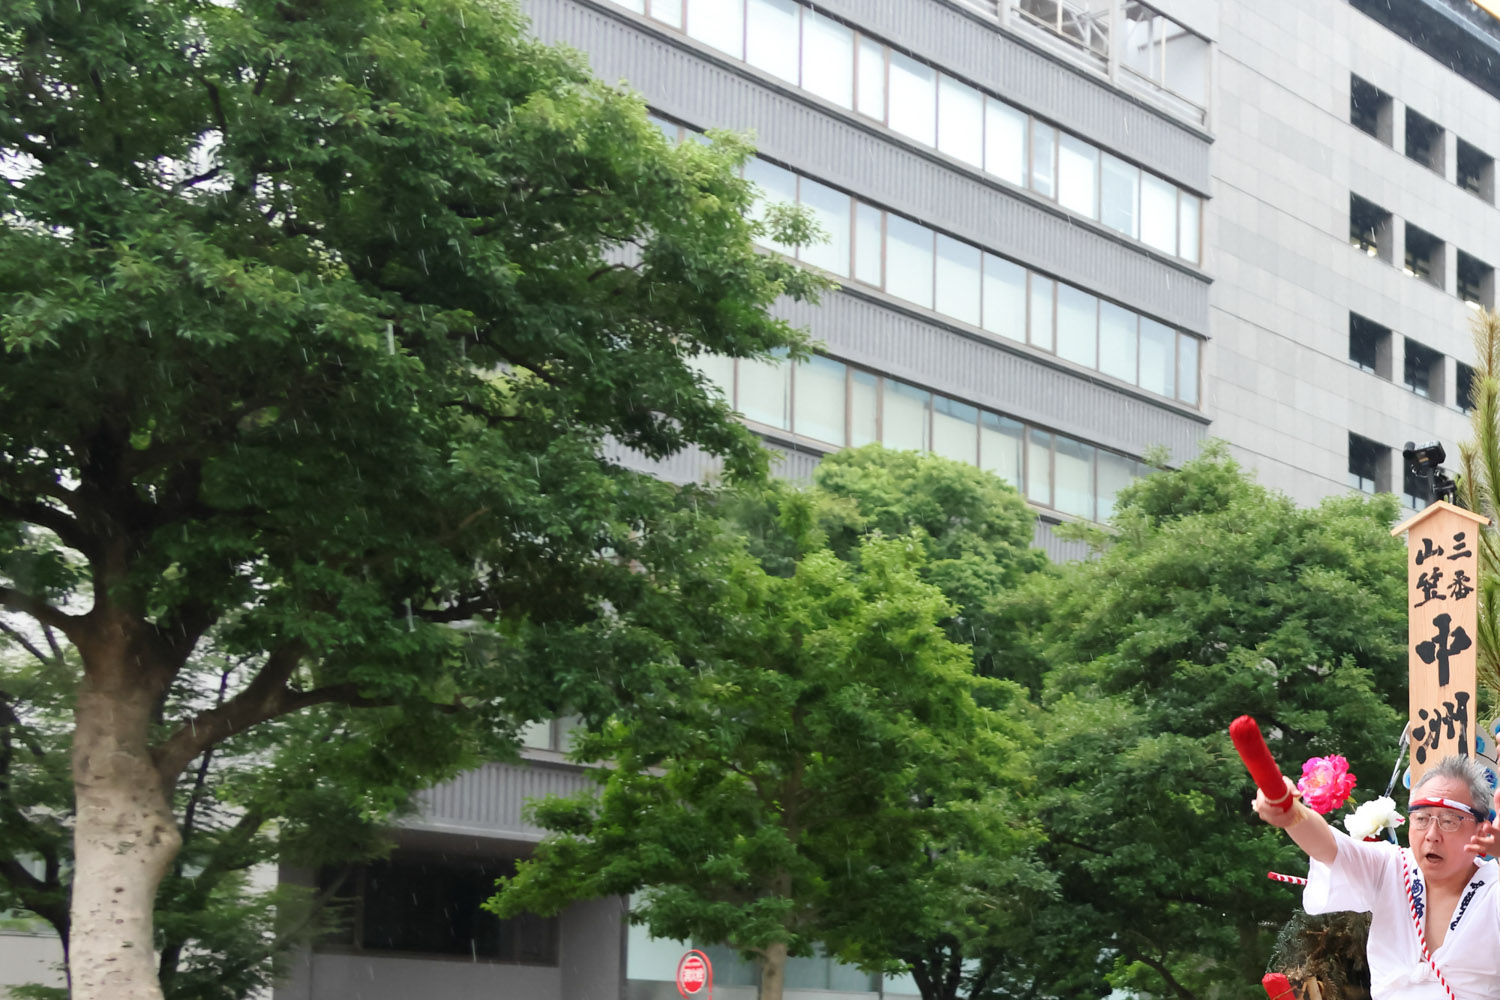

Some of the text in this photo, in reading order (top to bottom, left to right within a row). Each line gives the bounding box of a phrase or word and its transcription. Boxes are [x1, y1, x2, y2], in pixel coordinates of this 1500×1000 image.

[1414, 538, 1447, 608] 山笠
[1447, 532, 1474, 600] 三番
[1412, 613, 1472, 765] 中洲
